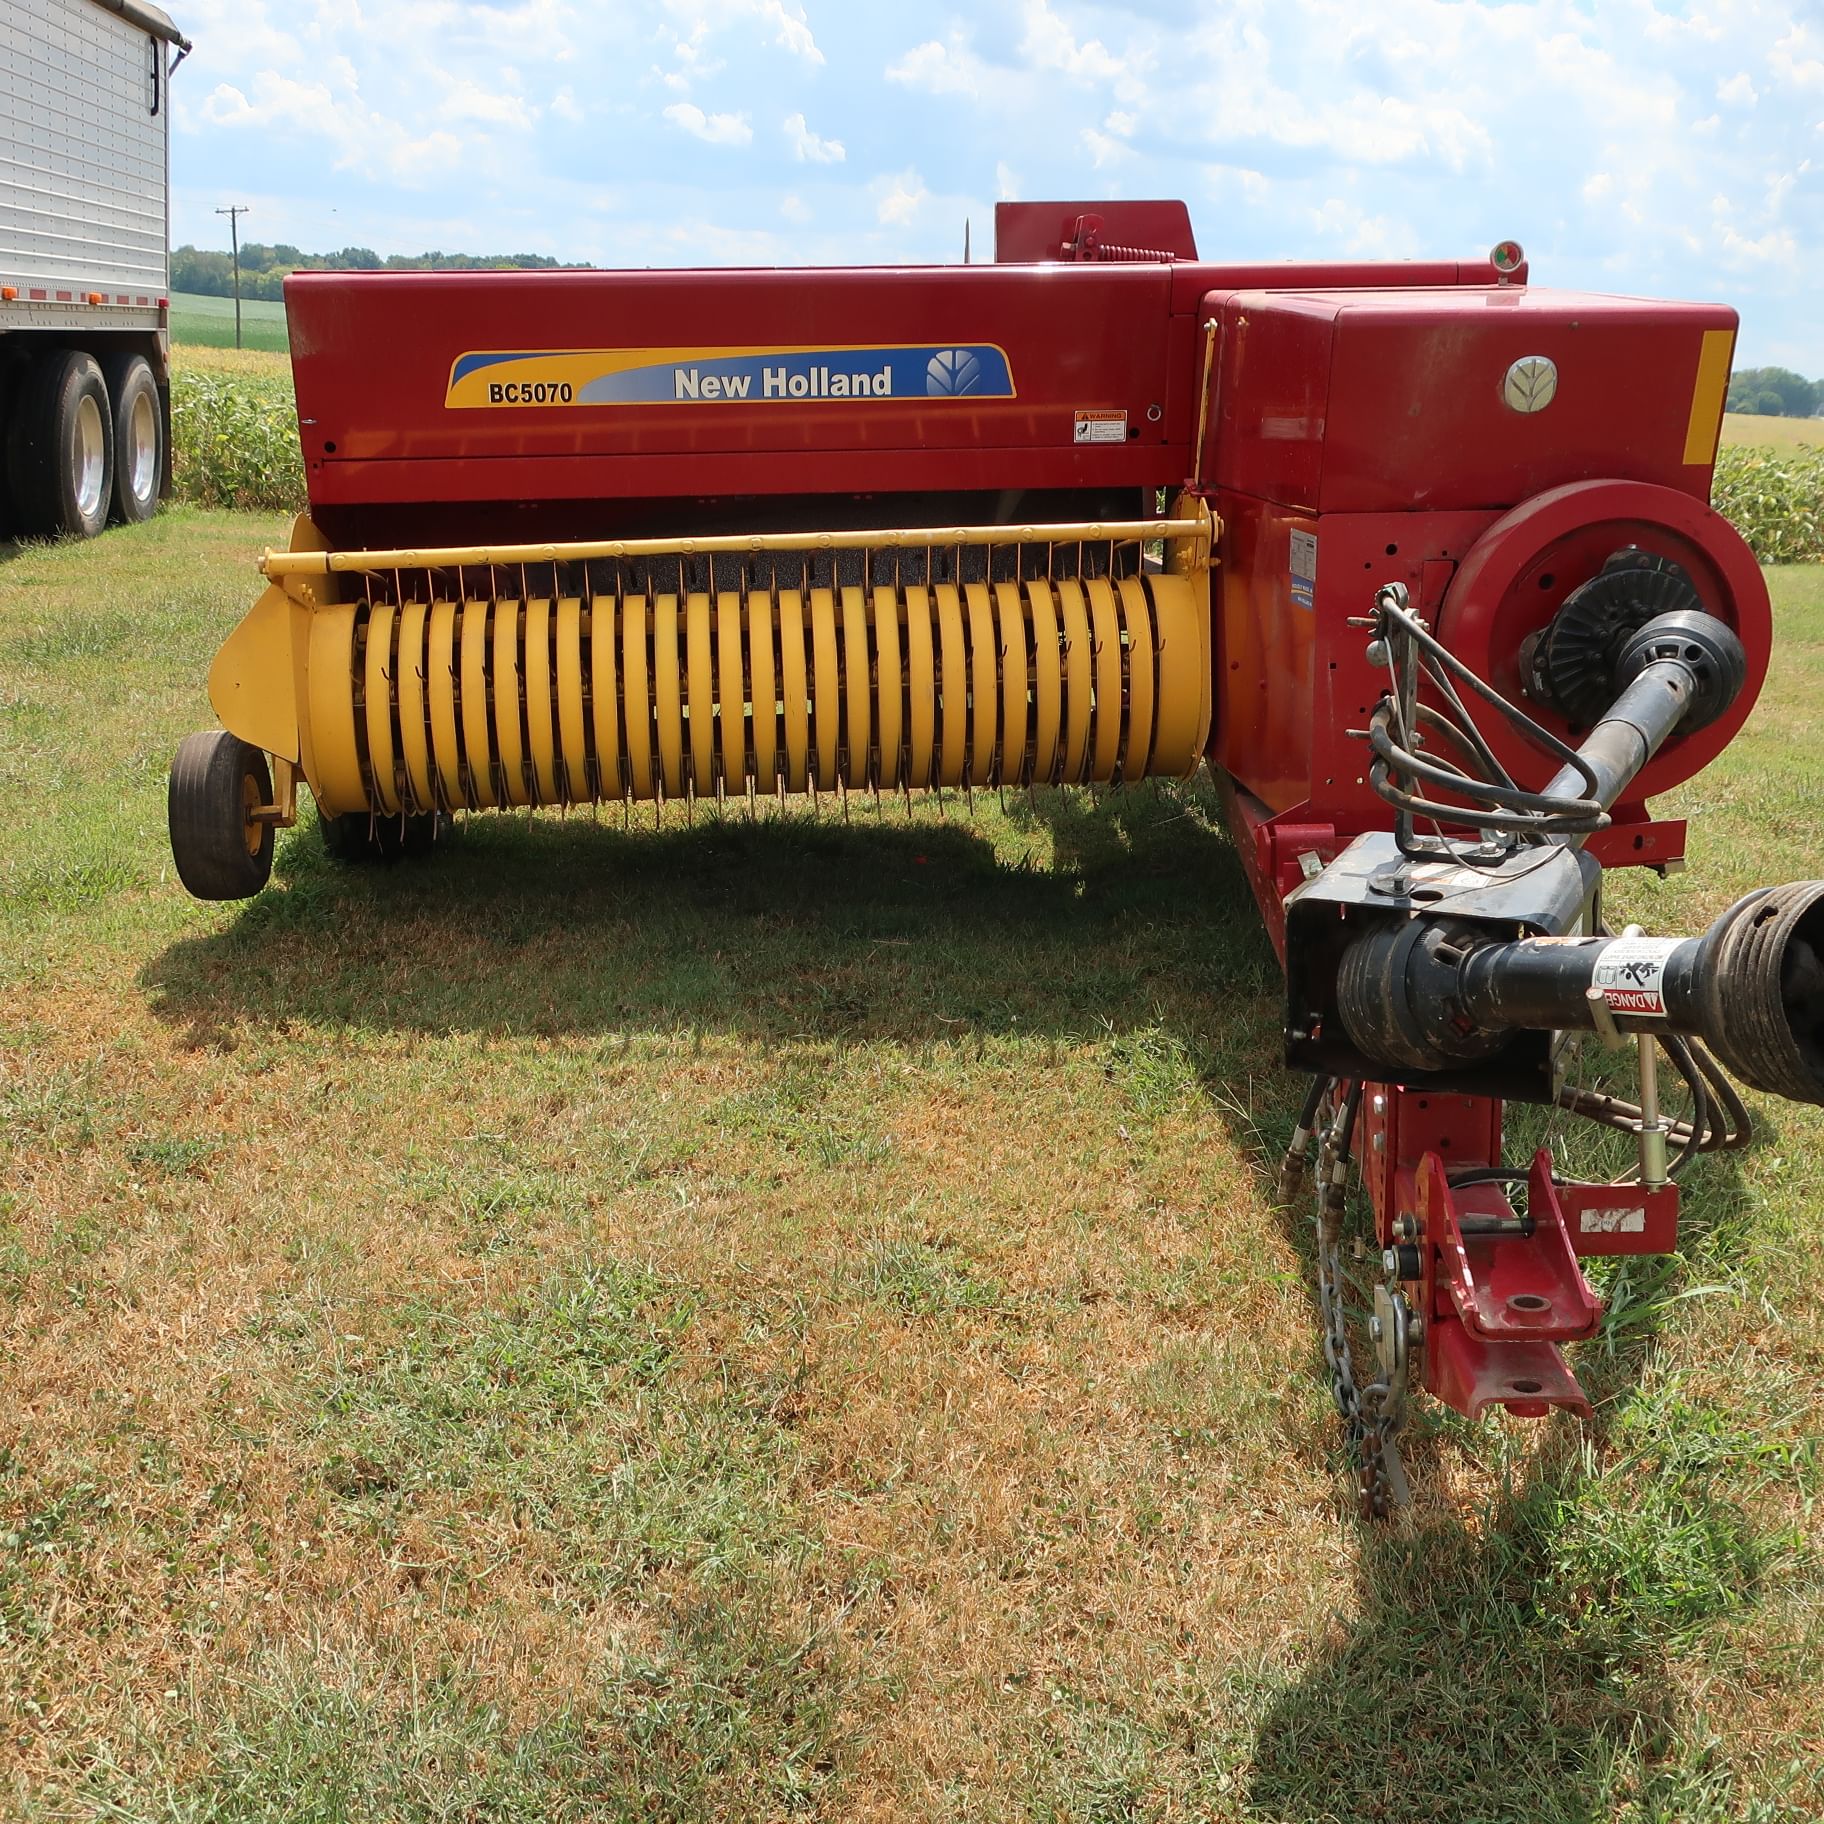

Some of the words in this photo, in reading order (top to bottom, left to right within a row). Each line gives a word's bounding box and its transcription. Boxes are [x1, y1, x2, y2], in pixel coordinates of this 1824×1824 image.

[674, 368, 750, 398] New
[762, 366, 892, 397] Holland
[489, 384, 572, 403] BC5070
[1605, 992, 1645, 1008] DANGE
